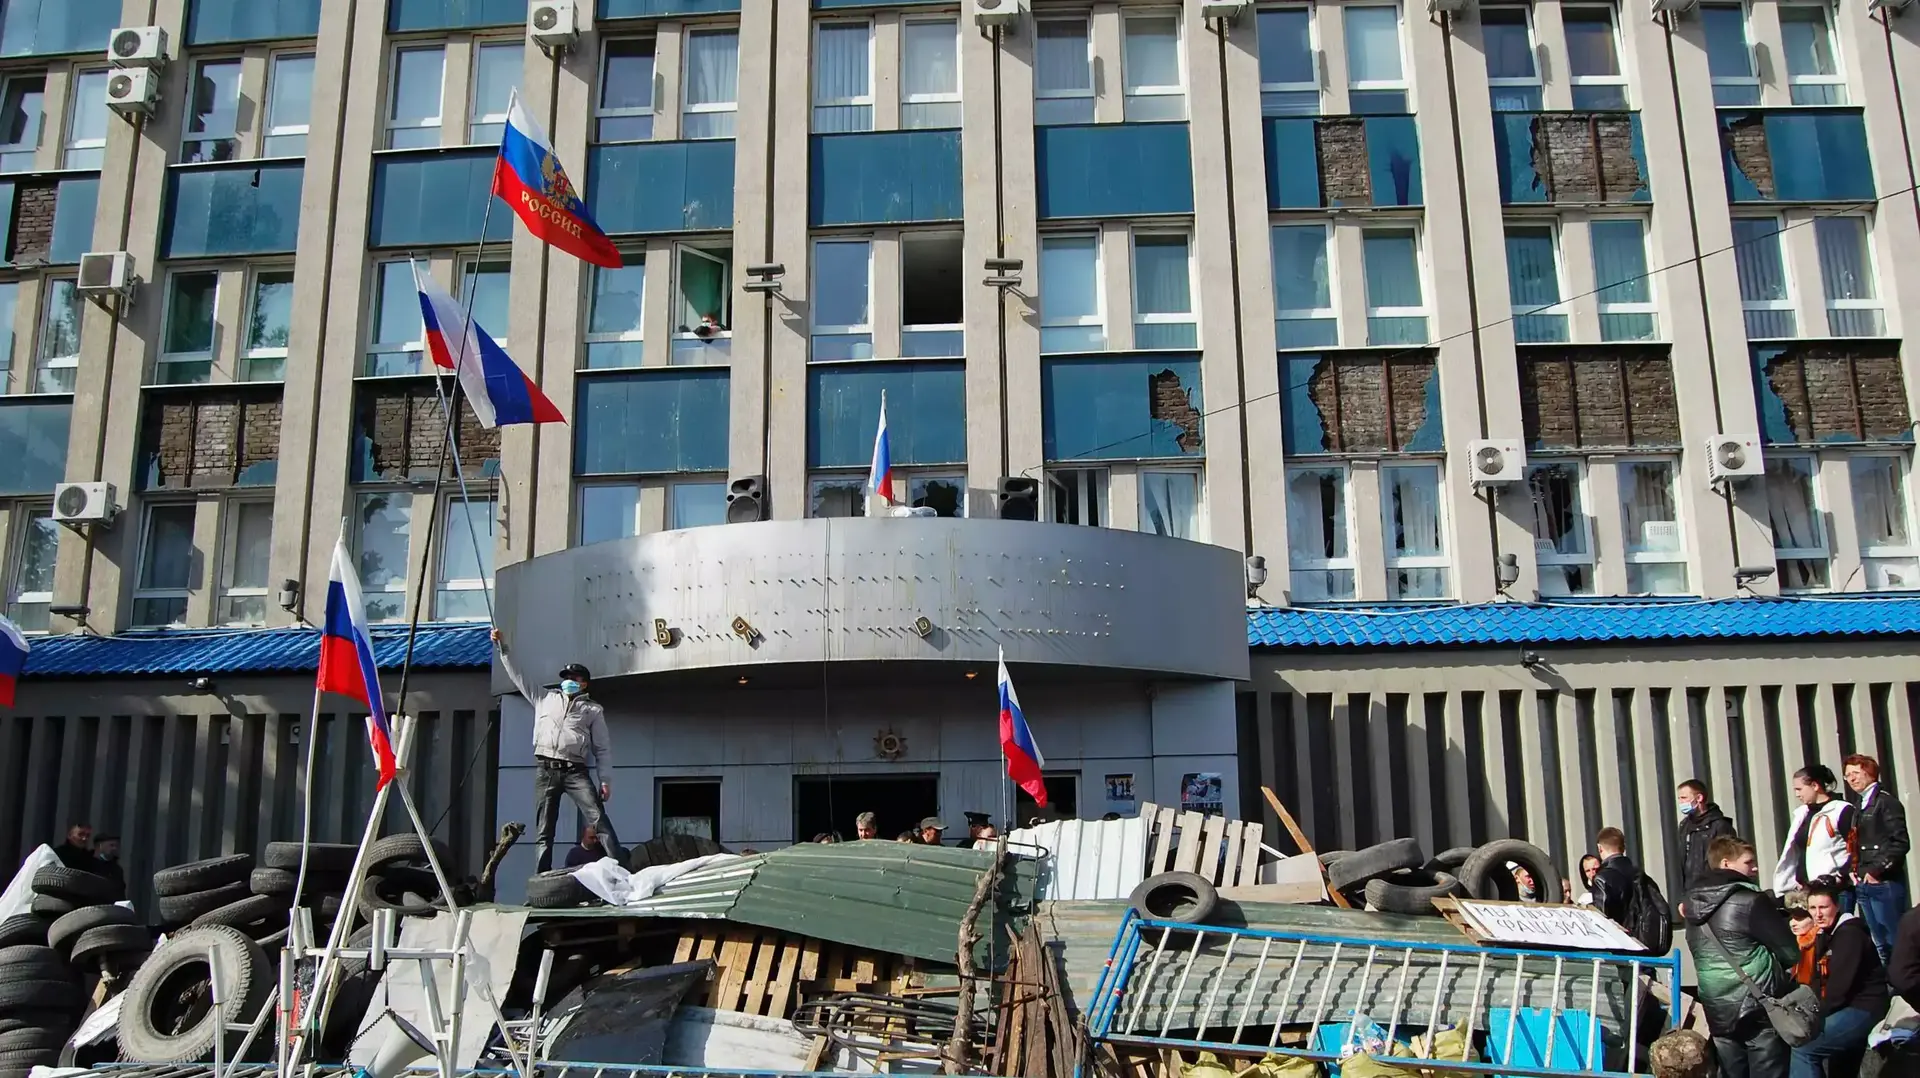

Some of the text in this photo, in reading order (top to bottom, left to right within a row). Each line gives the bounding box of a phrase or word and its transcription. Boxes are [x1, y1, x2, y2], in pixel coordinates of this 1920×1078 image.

[521, 190, 582, 239] РОССИЯ
[1474, 906, 1593, 922] МЫ ПРОТИВ
[1497, 919, 1608, 938] ФАШЗМА!
